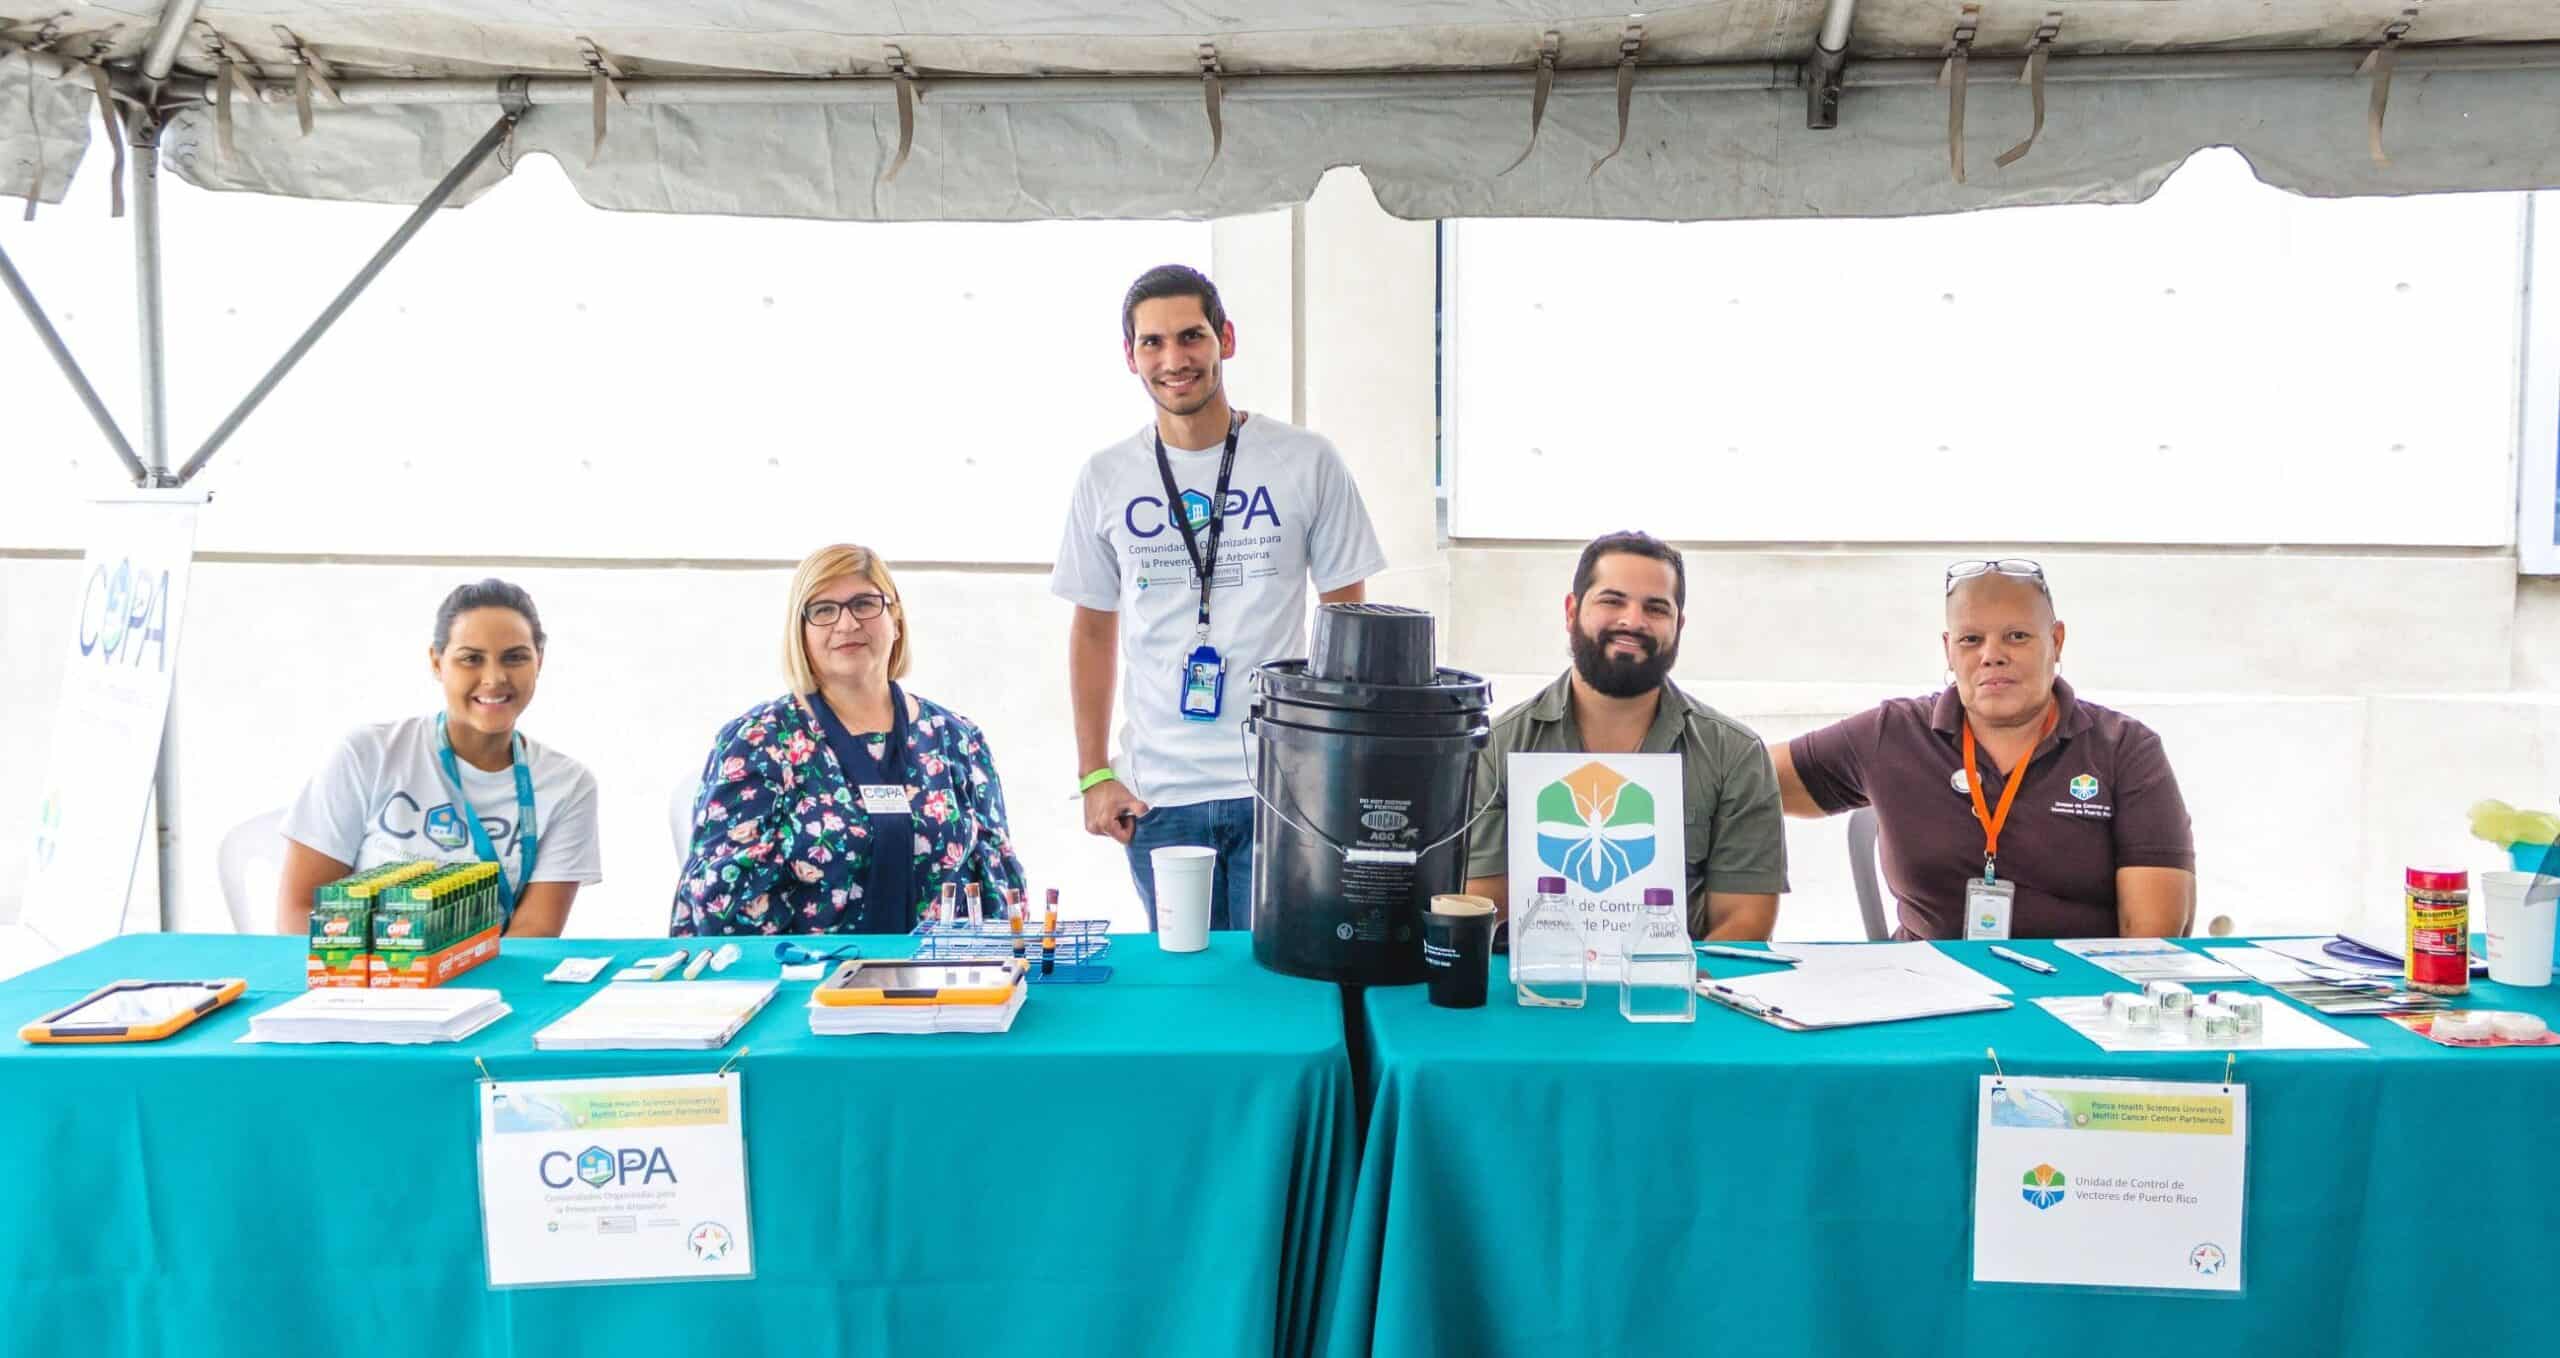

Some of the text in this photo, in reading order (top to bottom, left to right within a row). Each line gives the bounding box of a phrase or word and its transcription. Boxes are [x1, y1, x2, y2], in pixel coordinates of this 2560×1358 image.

[1128, 534, 1282, 555] Comunidad Oanizadas para
[1226, 551, 1270, 562] Arbovirus
[1370, 831, 1395, 841] AGO
[1578, 900, 1596, 912] de
[1599, 900, 1645, 913] Contro
[1602, 920, 1632, 931] Puer
[2117, 1102, 2144, 1112] Health
[2146, 1103, 2181, 1113] Sciences
[2120, 1112, 2149, 1122] Cancer
[2150, 1113, 2177, 1123] Center
[2179, 1115, 2225, 1126] Partnership
[539, 1145, 678, 1189] COPA
[2075, 1176, 2185, 1190] Unidad de Control de
[2076, 1190, 2198, 1205] Vectores de Puerto Rico
